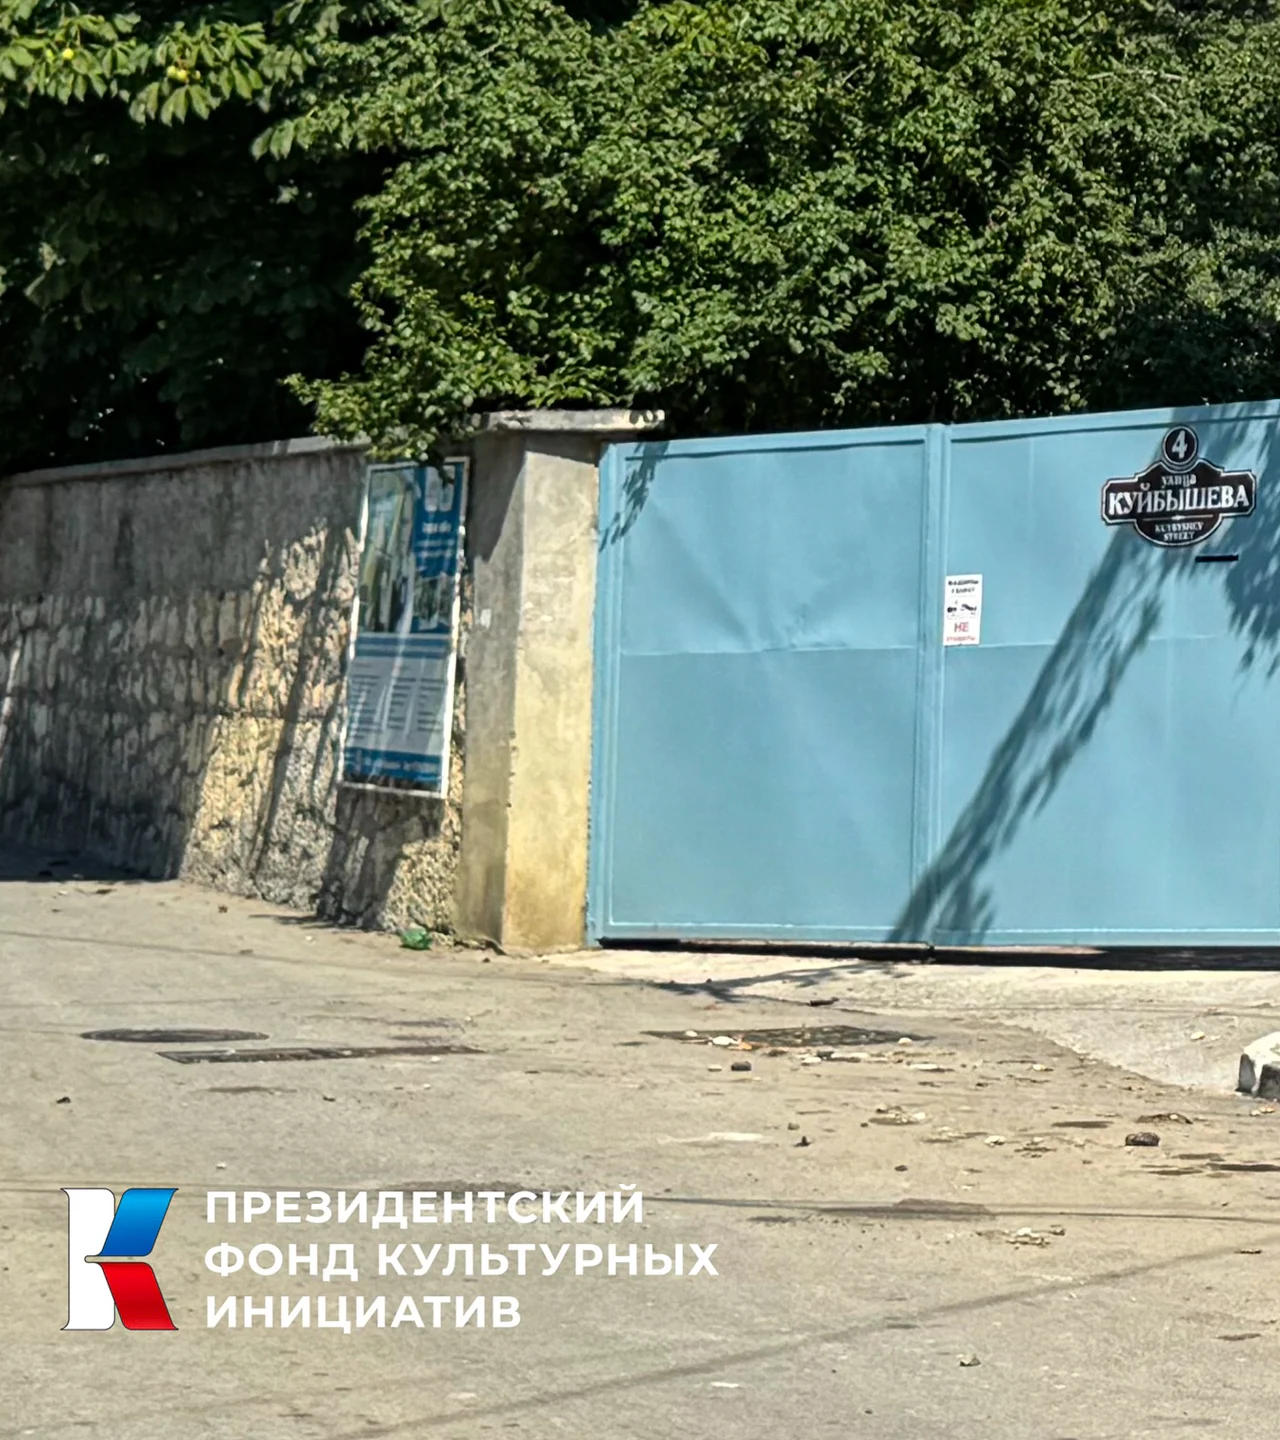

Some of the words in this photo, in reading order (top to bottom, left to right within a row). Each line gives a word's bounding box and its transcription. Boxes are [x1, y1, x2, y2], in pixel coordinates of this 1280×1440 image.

[1172, 431, 1188, 458] 4
[1161, 474, 1197, 489] улица
[1108, 483, 1249, 515] КУЙБЫШЕВА
